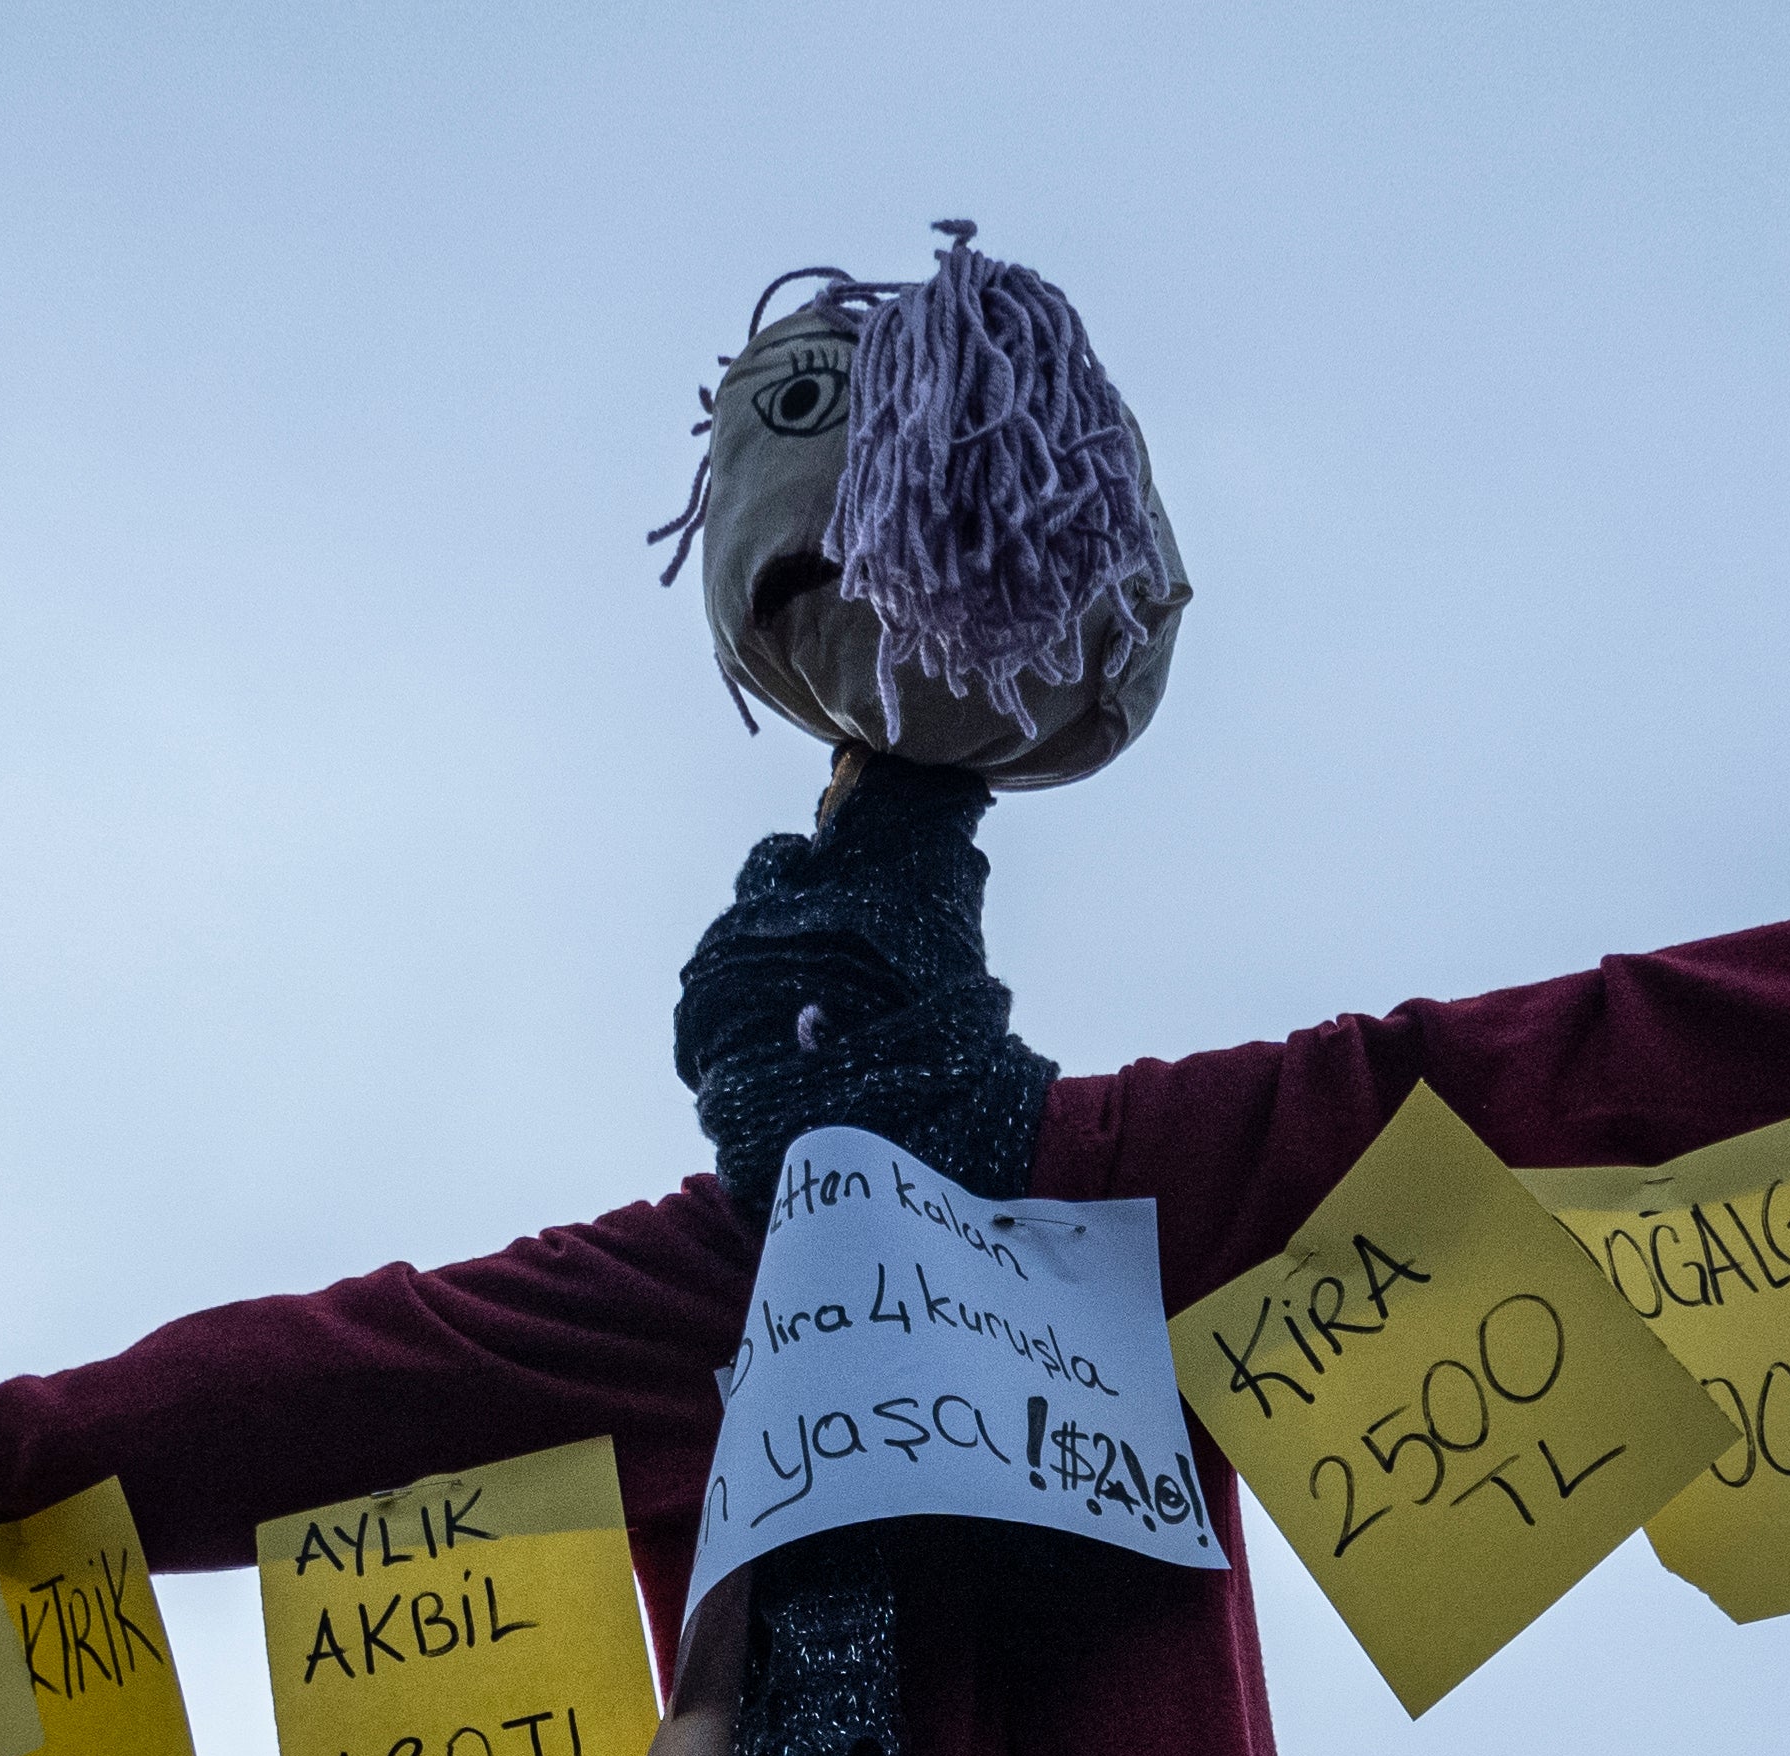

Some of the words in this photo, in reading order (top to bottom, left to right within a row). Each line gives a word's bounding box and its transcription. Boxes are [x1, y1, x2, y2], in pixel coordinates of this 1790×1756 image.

[771, 1160, 870, 1234] tten
[893, 1162, 1028, 1280] kalan
[763, 1300, 852, 1353] lira
[1213, 1234, 1430, 1419] KİRA
[1309, 1293, 1565, 1558] 2500
[297, 1489, 499, 1576] AYLIK
[1450, 1440, 1626, 1525] TL
[305, 1570, 538, 1683] AKBİL
